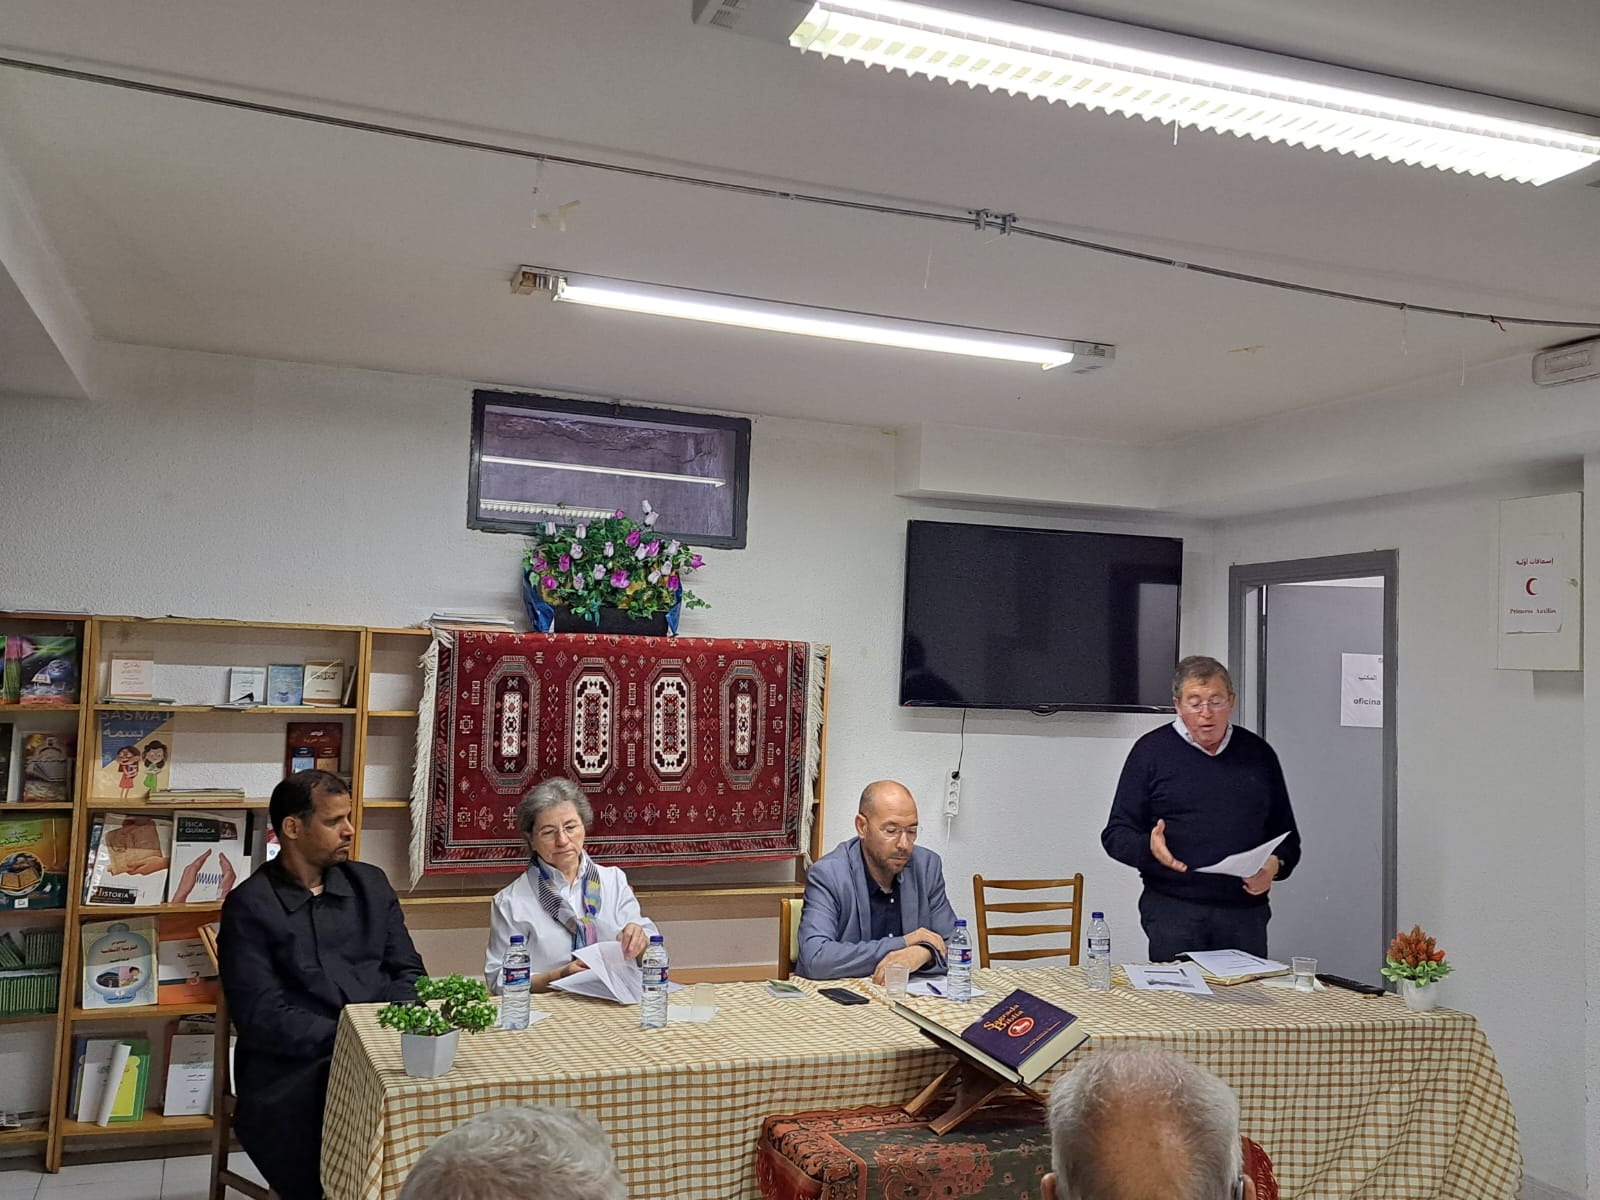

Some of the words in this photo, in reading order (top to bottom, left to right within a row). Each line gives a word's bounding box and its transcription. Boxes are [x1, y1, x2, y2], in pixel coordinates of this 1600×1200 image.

[1353, 697, 1381, 706] oficina
[190, 970, 200, 985] 3
[983, 1004, 1020, 1030] Sagrada
[995, 1010, 1024, 1032] Biblia
